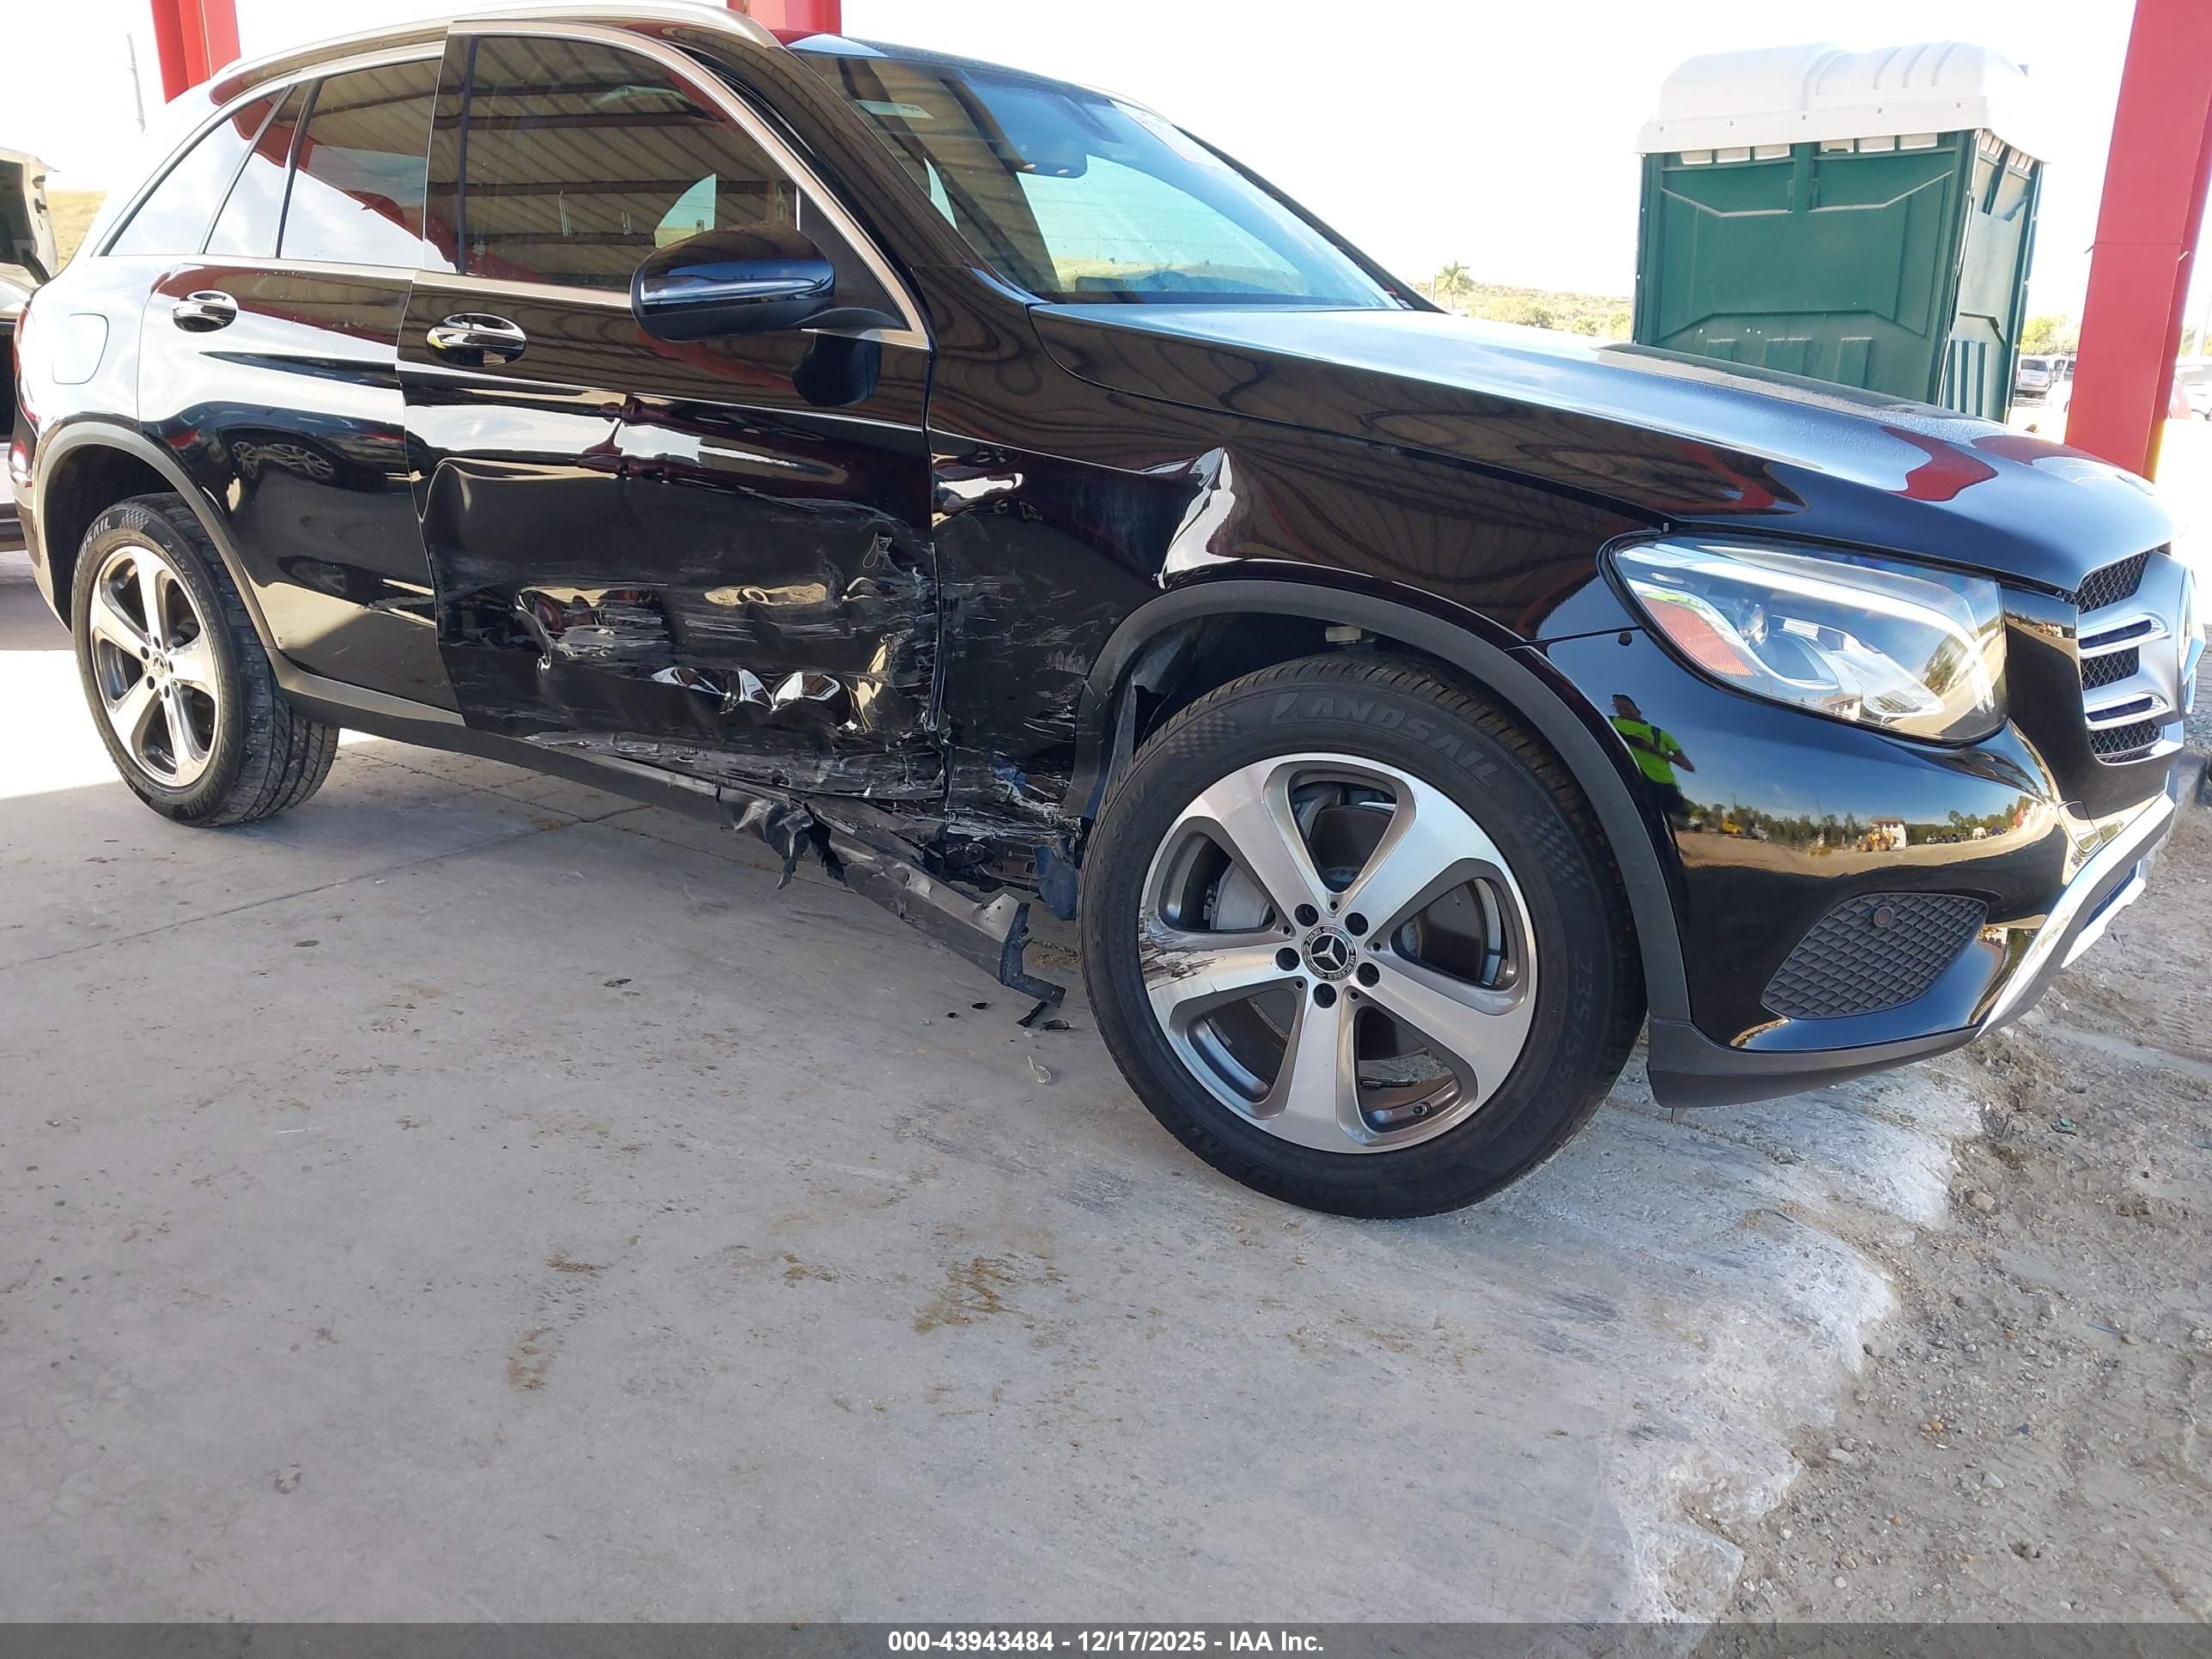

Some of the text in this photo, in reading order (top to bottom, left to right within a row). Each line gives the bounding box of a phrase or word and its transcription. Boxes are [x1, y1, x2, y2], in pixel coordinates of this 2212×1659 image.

[1270, 691, 1498, 791] LANDSAIL
[1305, 928, 1356, 980] MERCEDES BENZ
